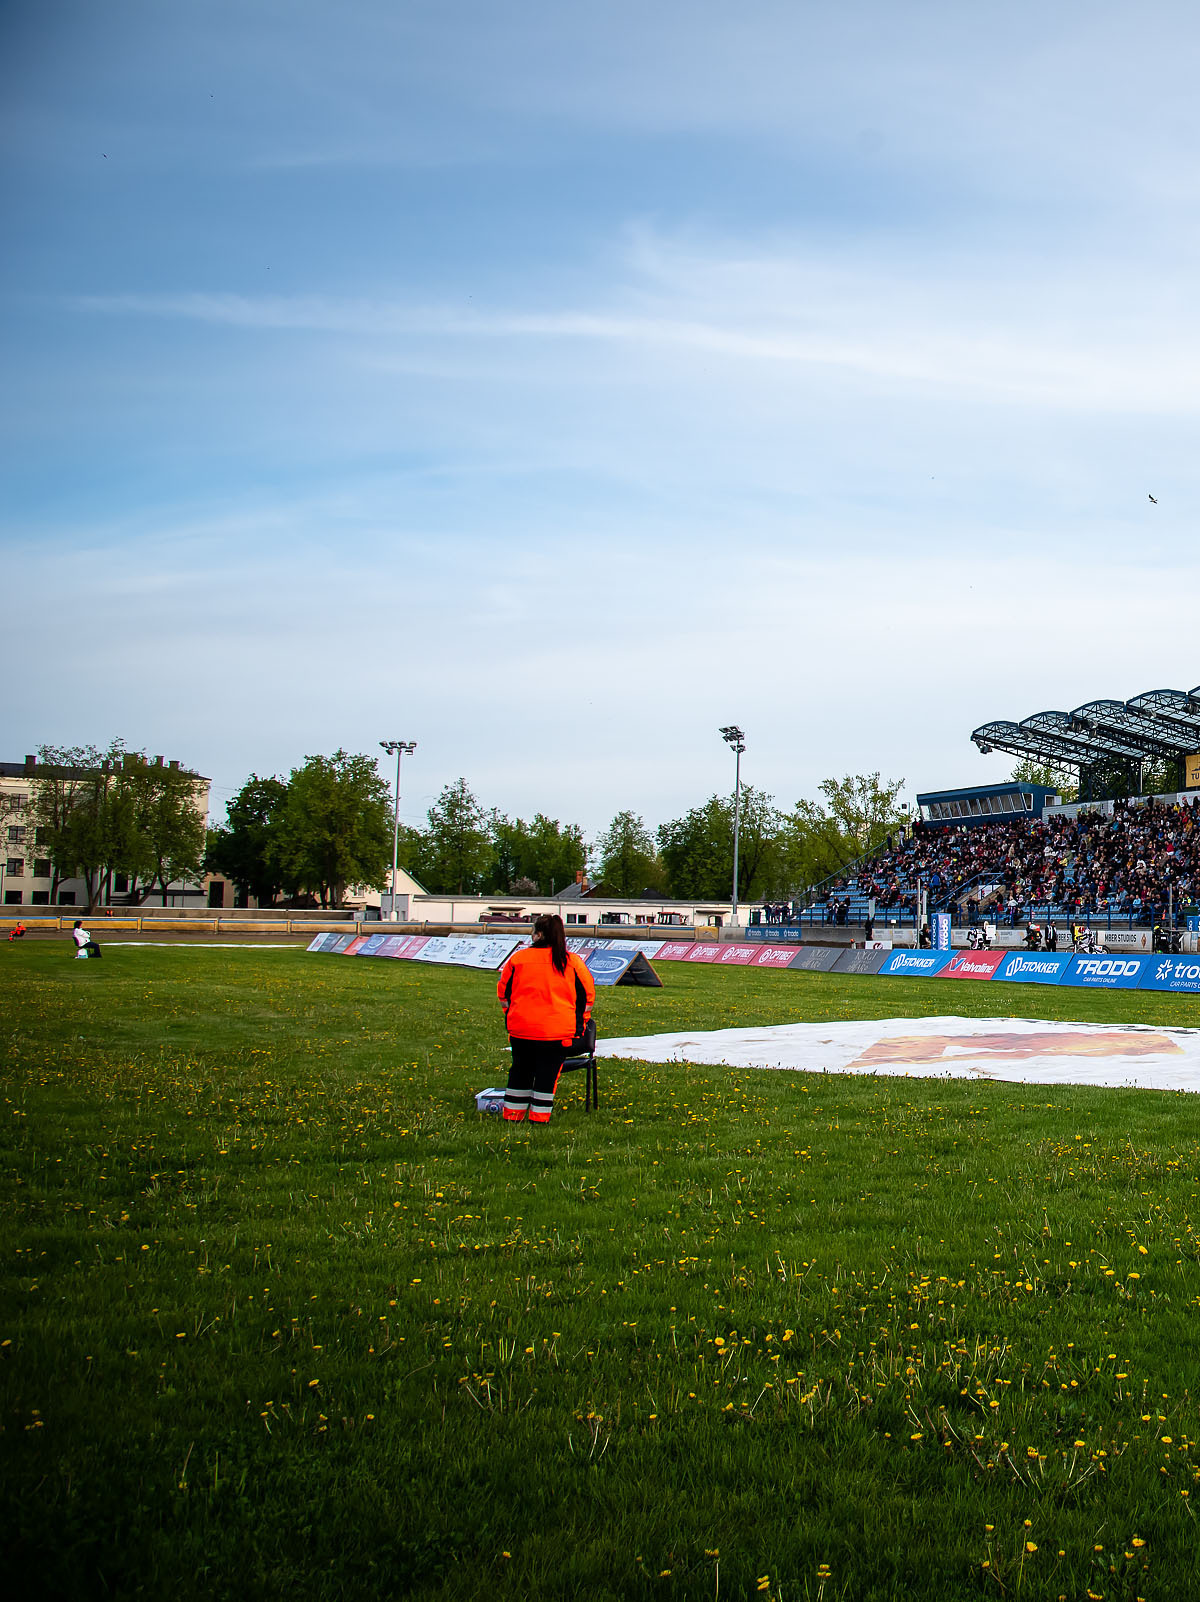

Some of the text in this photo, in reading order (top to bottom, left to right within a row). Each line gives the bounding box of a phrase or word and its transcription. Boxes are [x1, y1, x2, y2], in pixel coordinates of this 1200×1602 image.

[1118, 933, 1137, 942] STUDIOS
[901, 956, 936, 968] STOKKER
[960, 961, 995, 974] Valvoline
[1019, 960, 1060, 974] STOKKER
[1075, 959, 1141, 976] TRODO
[1181, 981, 1197, 989] PARTS
